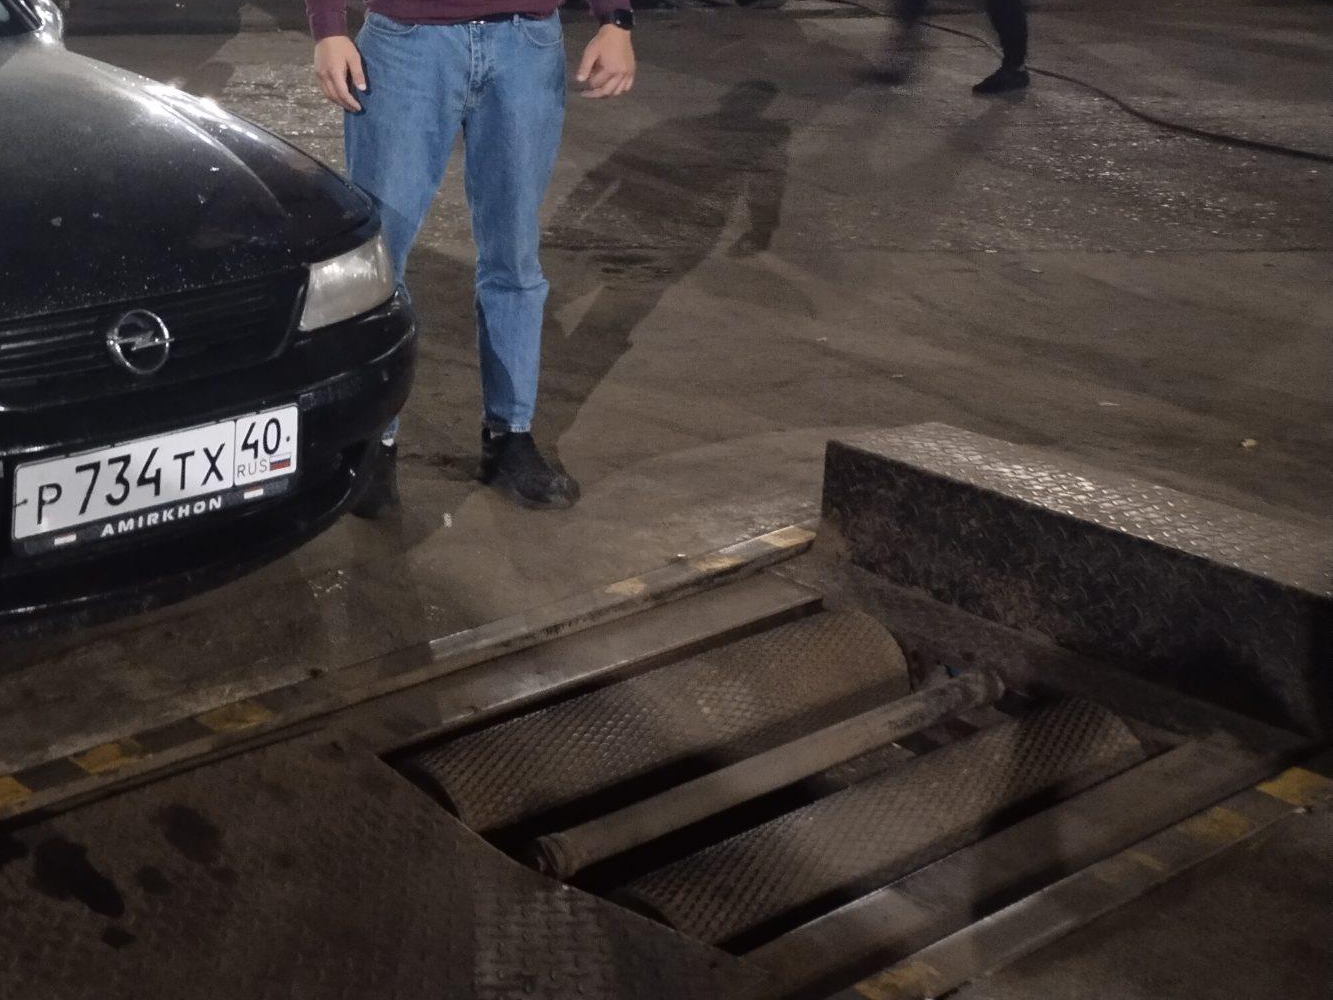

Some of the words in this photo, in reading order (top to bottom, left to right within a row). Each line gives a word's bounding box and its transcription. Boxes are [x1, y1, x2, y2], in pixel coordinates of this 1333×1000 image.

[241, 418, 281, 459] 40
[237, 458, 267, 478] RUS
[100, 497, 222, 538] AMIRKHON
